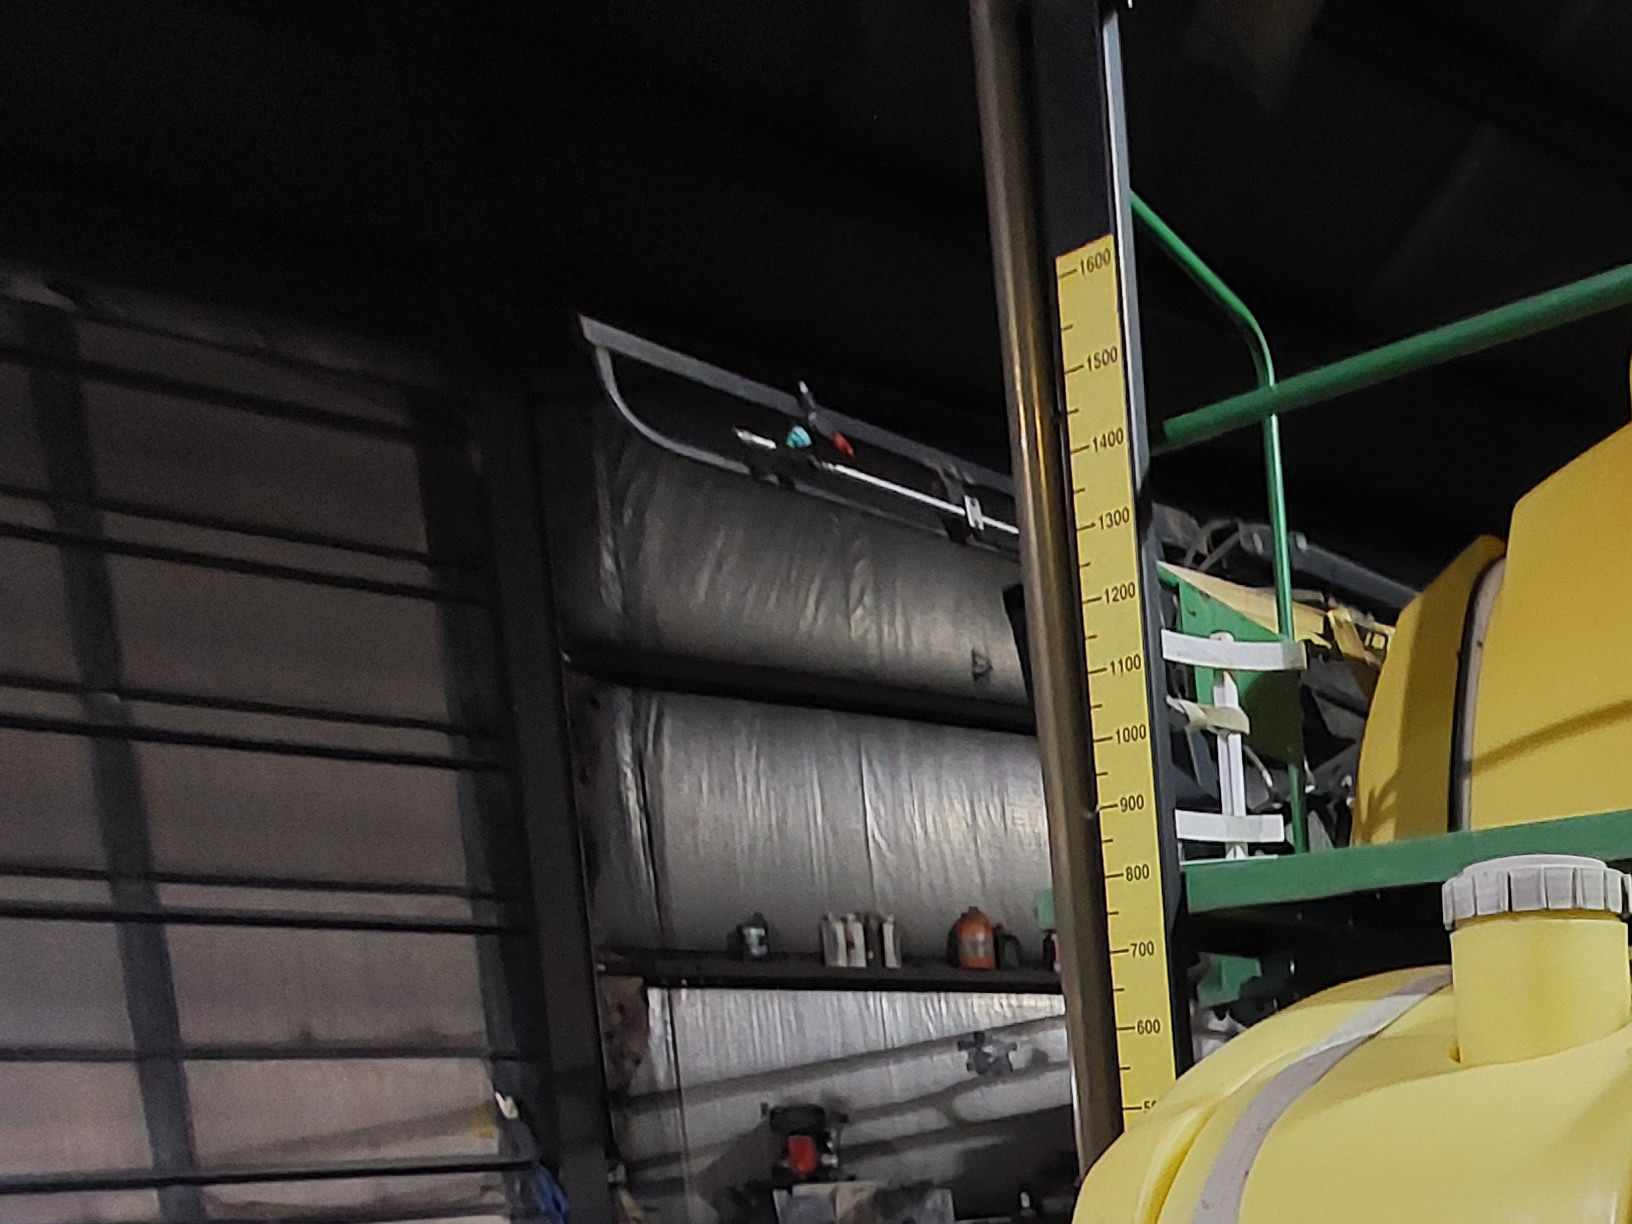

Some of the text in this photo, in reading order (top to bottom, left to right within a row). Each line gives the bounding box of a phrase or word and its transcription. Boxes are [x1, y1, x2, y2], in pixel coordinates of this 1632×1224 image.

[1078, 248, 1111, 277] 1600
[1085, 346, 1118, 373] 1500
[1091, 428, 1124, 453] 1400
[1097, 507, 1130, 530] 1300
[1103, 582, 1136, 604] 1200
[1109, 654, 1142, 674] 1100
[1114, 724, 1147, 745] 1000
[1119, 794, 1145, 812] 900
[1124, 864, 1150, 881] 800
[1130, 940, 1155, 958] 700
[1136, 1018, 1161, 1036] 600
